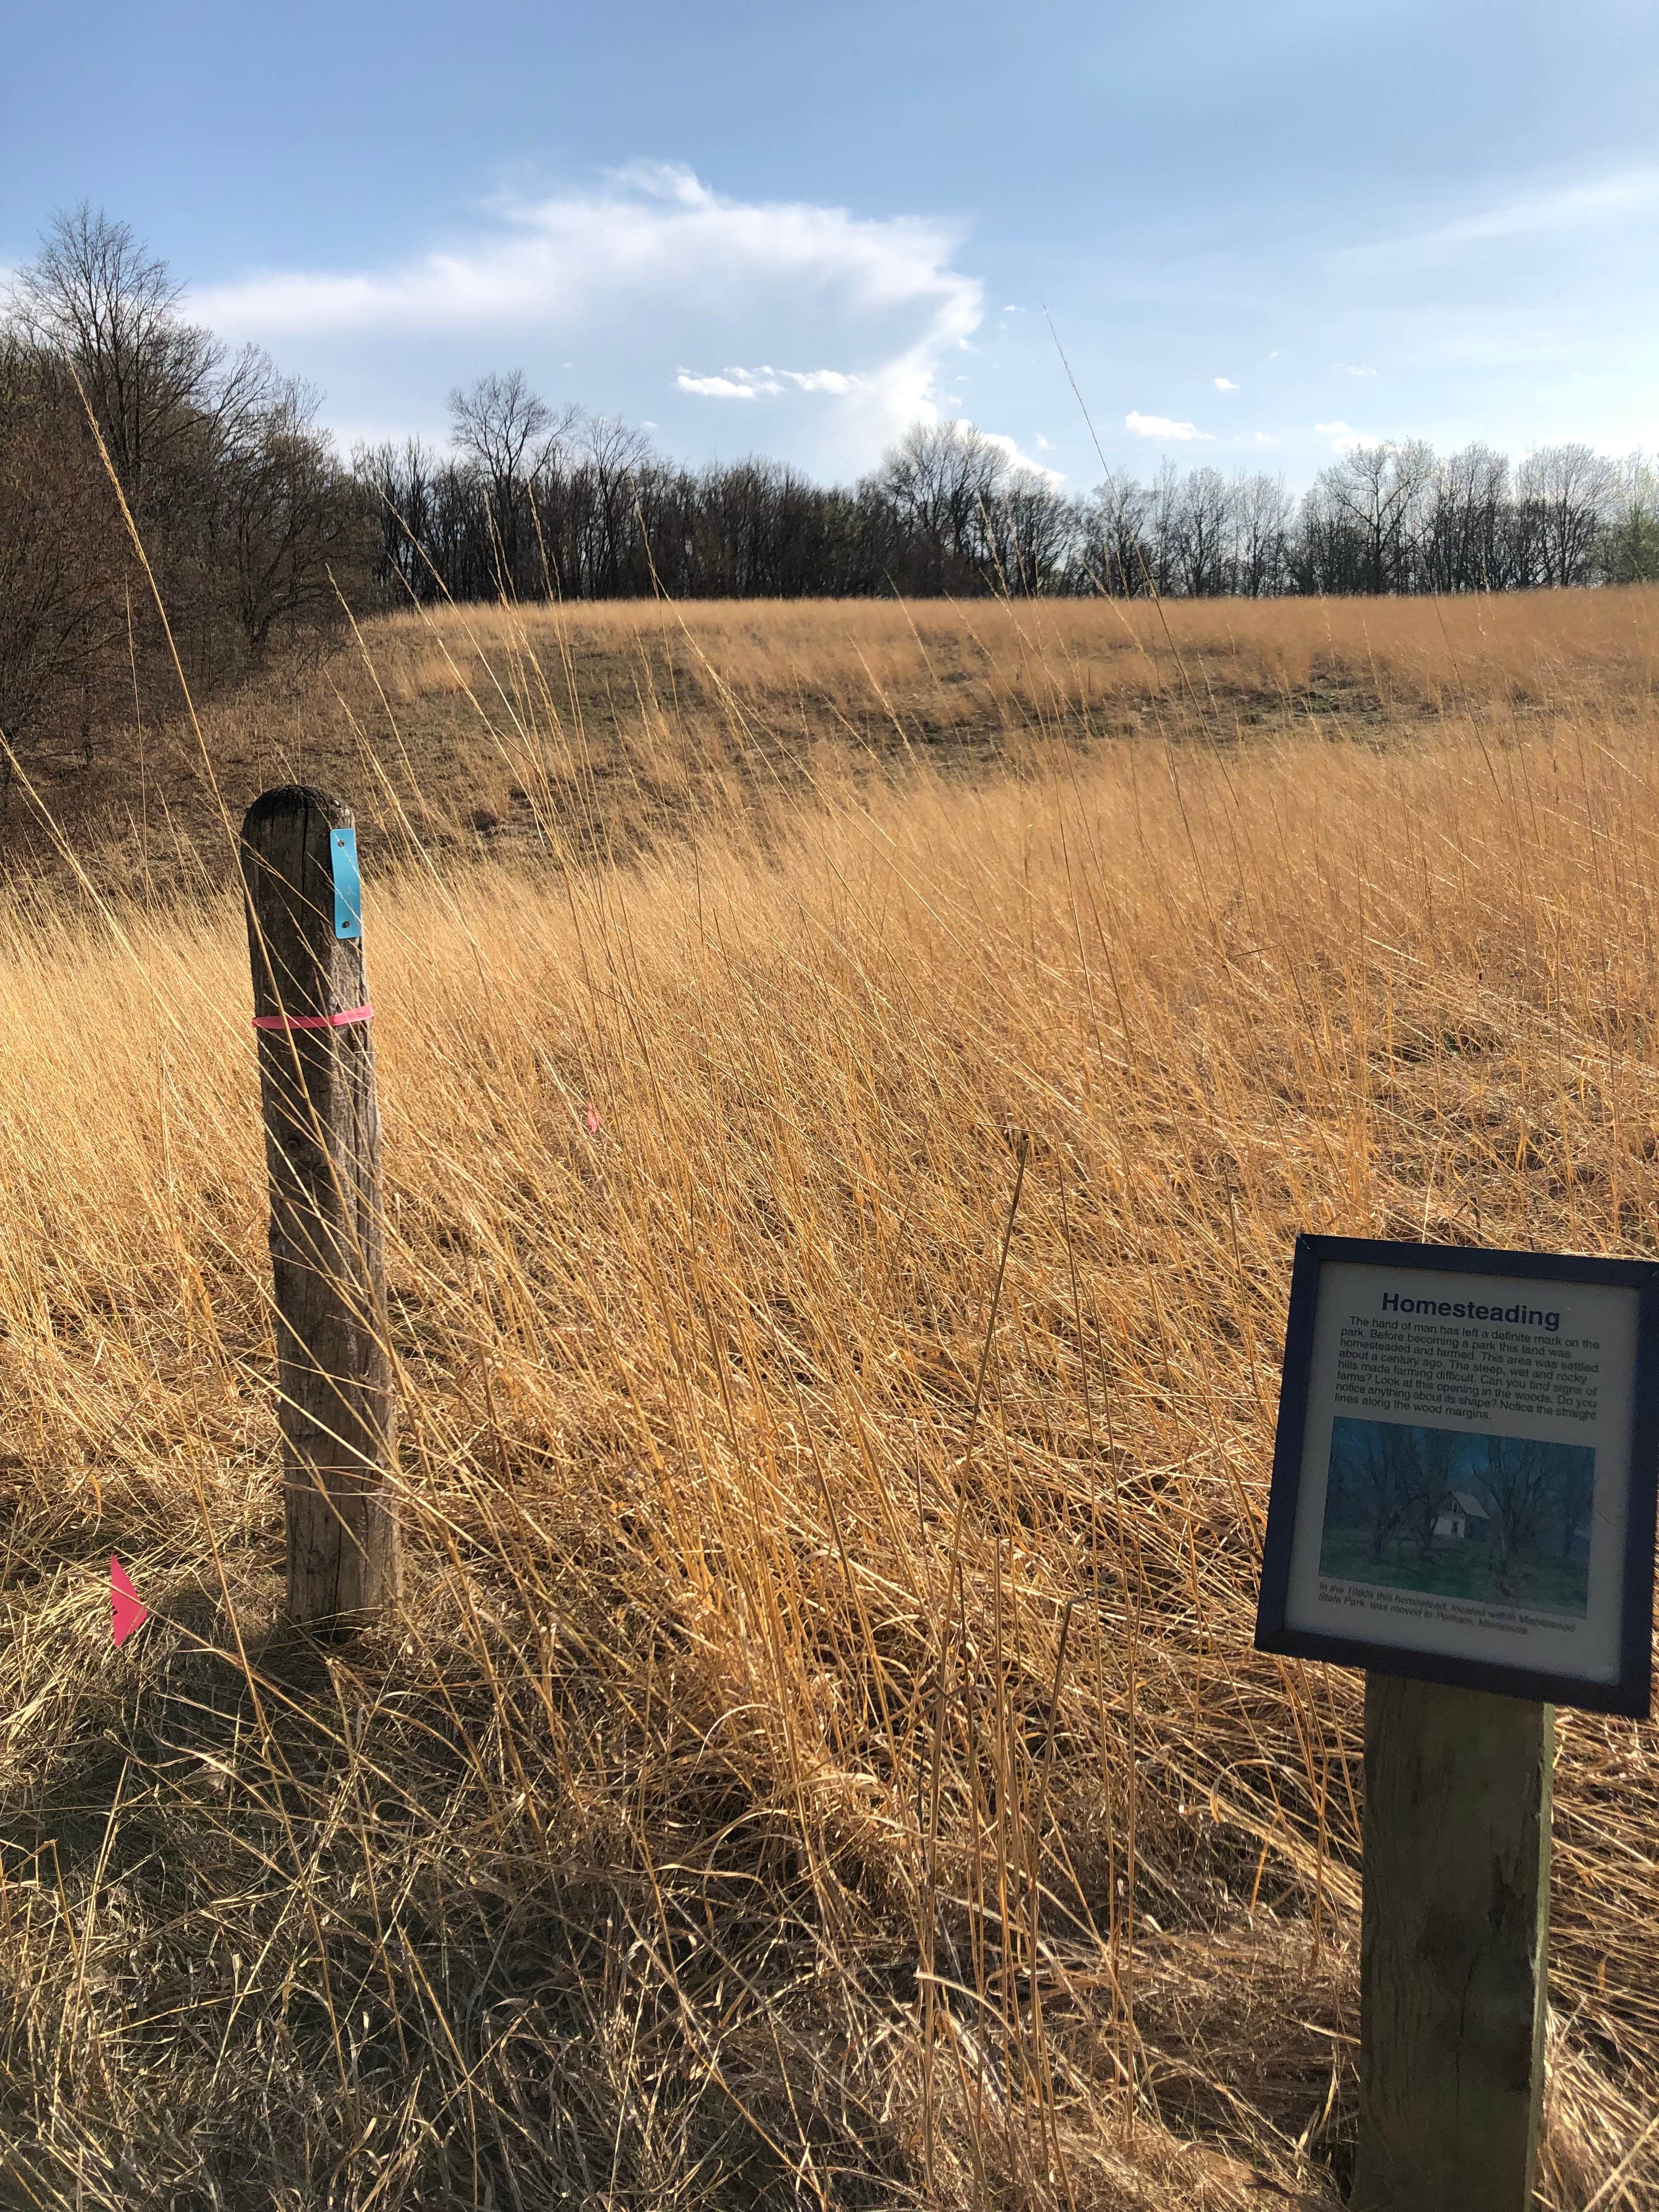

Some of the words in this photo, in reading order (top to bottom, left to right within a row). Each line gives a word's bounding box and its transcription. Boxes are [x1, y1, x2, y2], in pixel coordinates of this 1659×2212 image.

[1382, 1292, 1560, 1332] Homesteading
[1340, 1328, 1366, 1340] park.
[1370, 1329, 1404, 1341] Before
[1407, 1333, 1459, 1348] becoming
[1472, 1341, 1495, 1351] park
[1499, 1342, 1518, 1352] this
[1522, 1344, 1544, 1355] land
[1548, 1349, 1571, 1358] was
[1350, 1316, 1369, 1326] The
[1372, 1318, 1398, 1329] hand
[1401, 1321, 1410, 1330] of
[1414, 1324, 1436, 1333] man
[1440, 1324, 1459, 1335] has
[1462, 1327, 1477, 1337] left
[1491, 1329, 1531, 1342] definite
[1534, 1336, 1561, 1345] mark
[1565, 1339, 1578, 1347] on
[1583, 1338, 1599, 1349] the
[1339, 1349, 1369, 1360] about
[1380, 1355, 1418, 1367] century
[1423, 1359, 1444, 1369] ago.
[1449, 1360, 1469, 1370] The
[1473, 1363, 1505, 1376] steep,
[1510, 1368, 1529, 1377] wet
[1533, 1370, 1553, 1380] and
[1556, 1373, 1587, 1385] rocky
[1340, 1338, 1410, 1353] homesteaded
[1413, 1346, 1433, 1355] and
[1481, 1352, 1503, 1363] This
[1507, 1356, 1531, 1365] area
[1535, 1359, 1558, 1368] was
[1561, 1361, 1598, 1372] settled
[1337, 1370, 1372, 1383] farms?
[1374, 1374, 1400, 1386] Look
[1402, 1378, 1413, 1387] at
[1415, 1379, 1433, 1390] this
[1437, 1384, 1478, 1397] opening
[1482, 1386, 1491, 1396] in
[1494, 1387, 1511, 1398] the
[1514, 1392, 1551, 1403] woods.
[1557, 1395, 1572, 1405] Do
[1576, 1399, 1597, 1409] you
[1338, 1359, 1358, 1370] hills
[1361, 1363, 1390, 1373] made
[1393, 1365, 1432, 1380] farming
[1480, 1374, 1502, 1386] Can
[1506, 1379, 1526, 1389] you
[1530, 1380, 1549, 1391] find
[1553, 1383, 1582, 1395] signs
[1585, 1386, 1597, 1396] of
[1335, 1392, 1358, 1404] lines
[1362, 1396, 1390, 1410] along
[1393, 1399, 1409, 1410] the
[1413, 1403, 1441, 1414] wood
[1445, 1407, 1491, 1419] margins.
[1336, 1383, 1365, 1393] notice
[1368, 1387, 1410, 1401] anything
[1413, 1391, 1441, 1402] about
[1444, 1393, 1455, 1404] its
[1458, 1396, 1496, 1409] shape?
[1500, 1400, 1532, 1413] Notice
[1536, 1404, 1552, 1415] the
[1556, 1407, 1596, 1421] straight
[1318, 1592, 1341, 1604] State
[1369, 1602, 1387, 1611] was
[1390, 1606, 1421, 1617] moved
[1319, 1582, 1327, 1591] In
[1330, 1583, 1344, 1594] the
[1376, 1591, 1392, 1601] this
